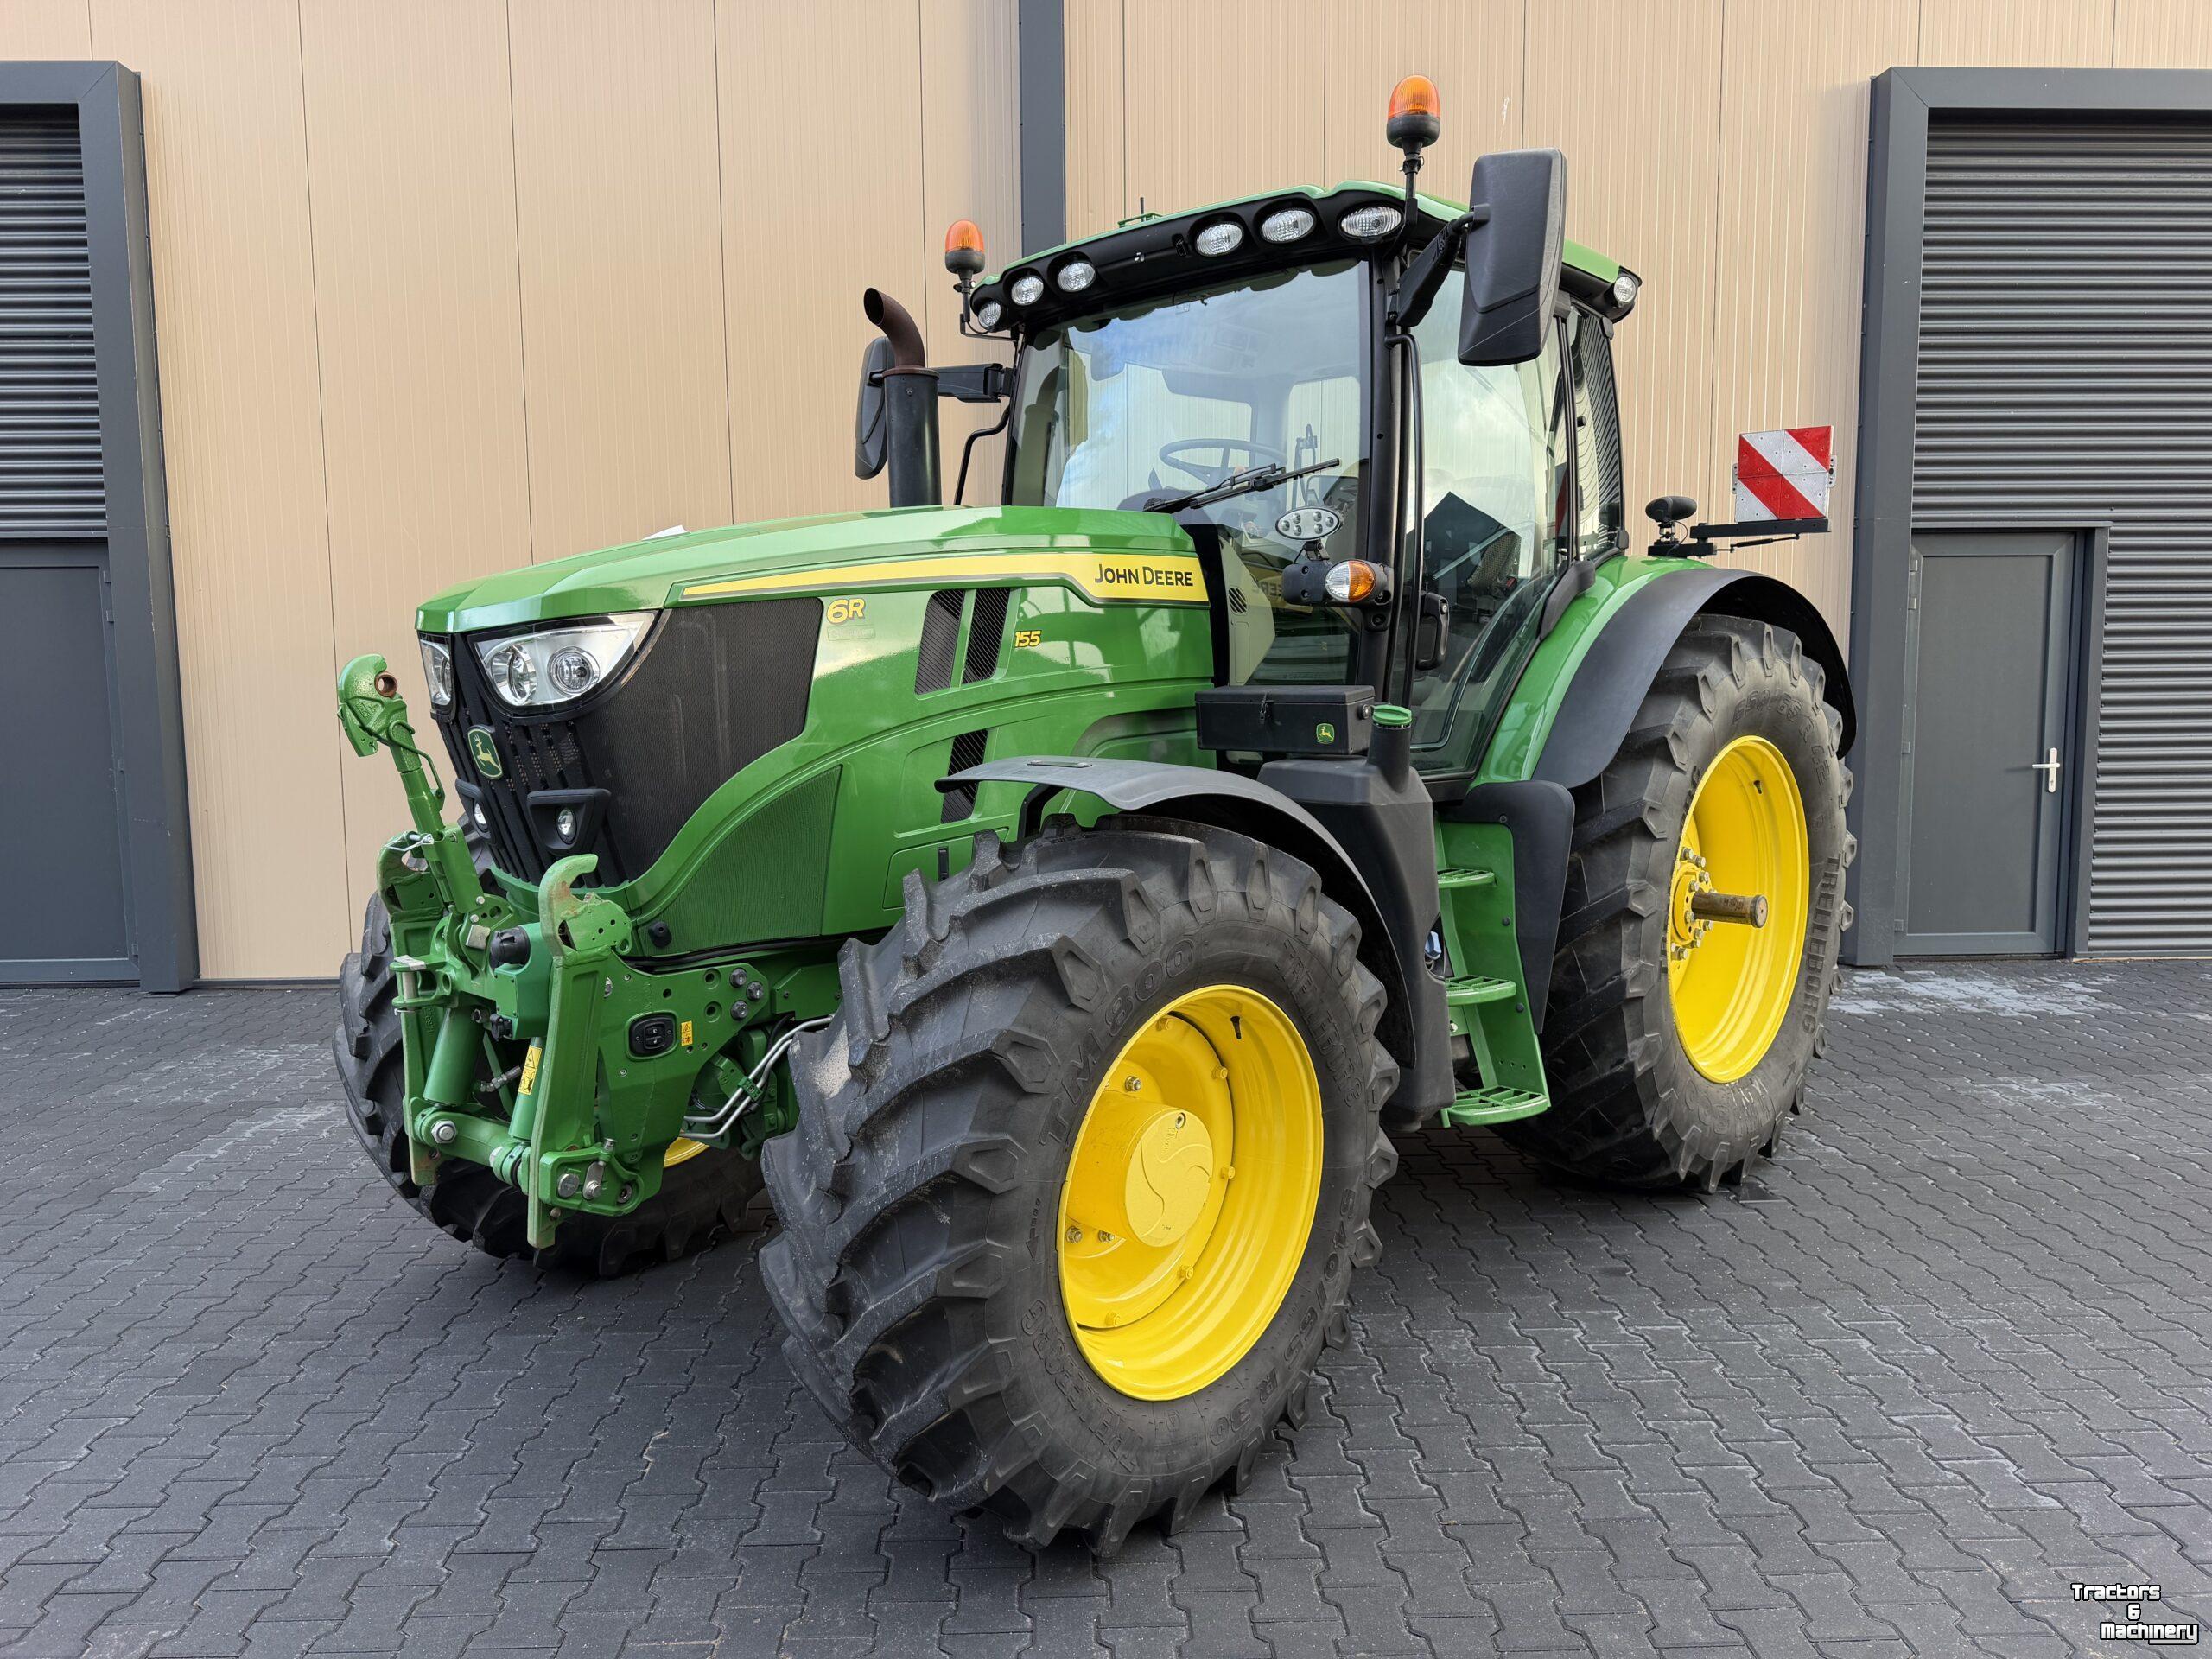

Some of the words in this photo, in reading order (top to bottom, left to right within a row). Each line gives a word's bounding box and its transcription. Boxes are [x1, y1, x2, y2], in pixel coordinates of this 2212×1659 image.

[1095, 563, 1139, 584] JOHN
[1142, 566, 1193, 587] DEERE
[827, 597, 866, 626] 6R
[1014, 629, 1042, 648] 155
[1802, 853, 1841, 1034] TRELLEBORG
[1274, 938, 1364, 1108] TRELLEBORG
